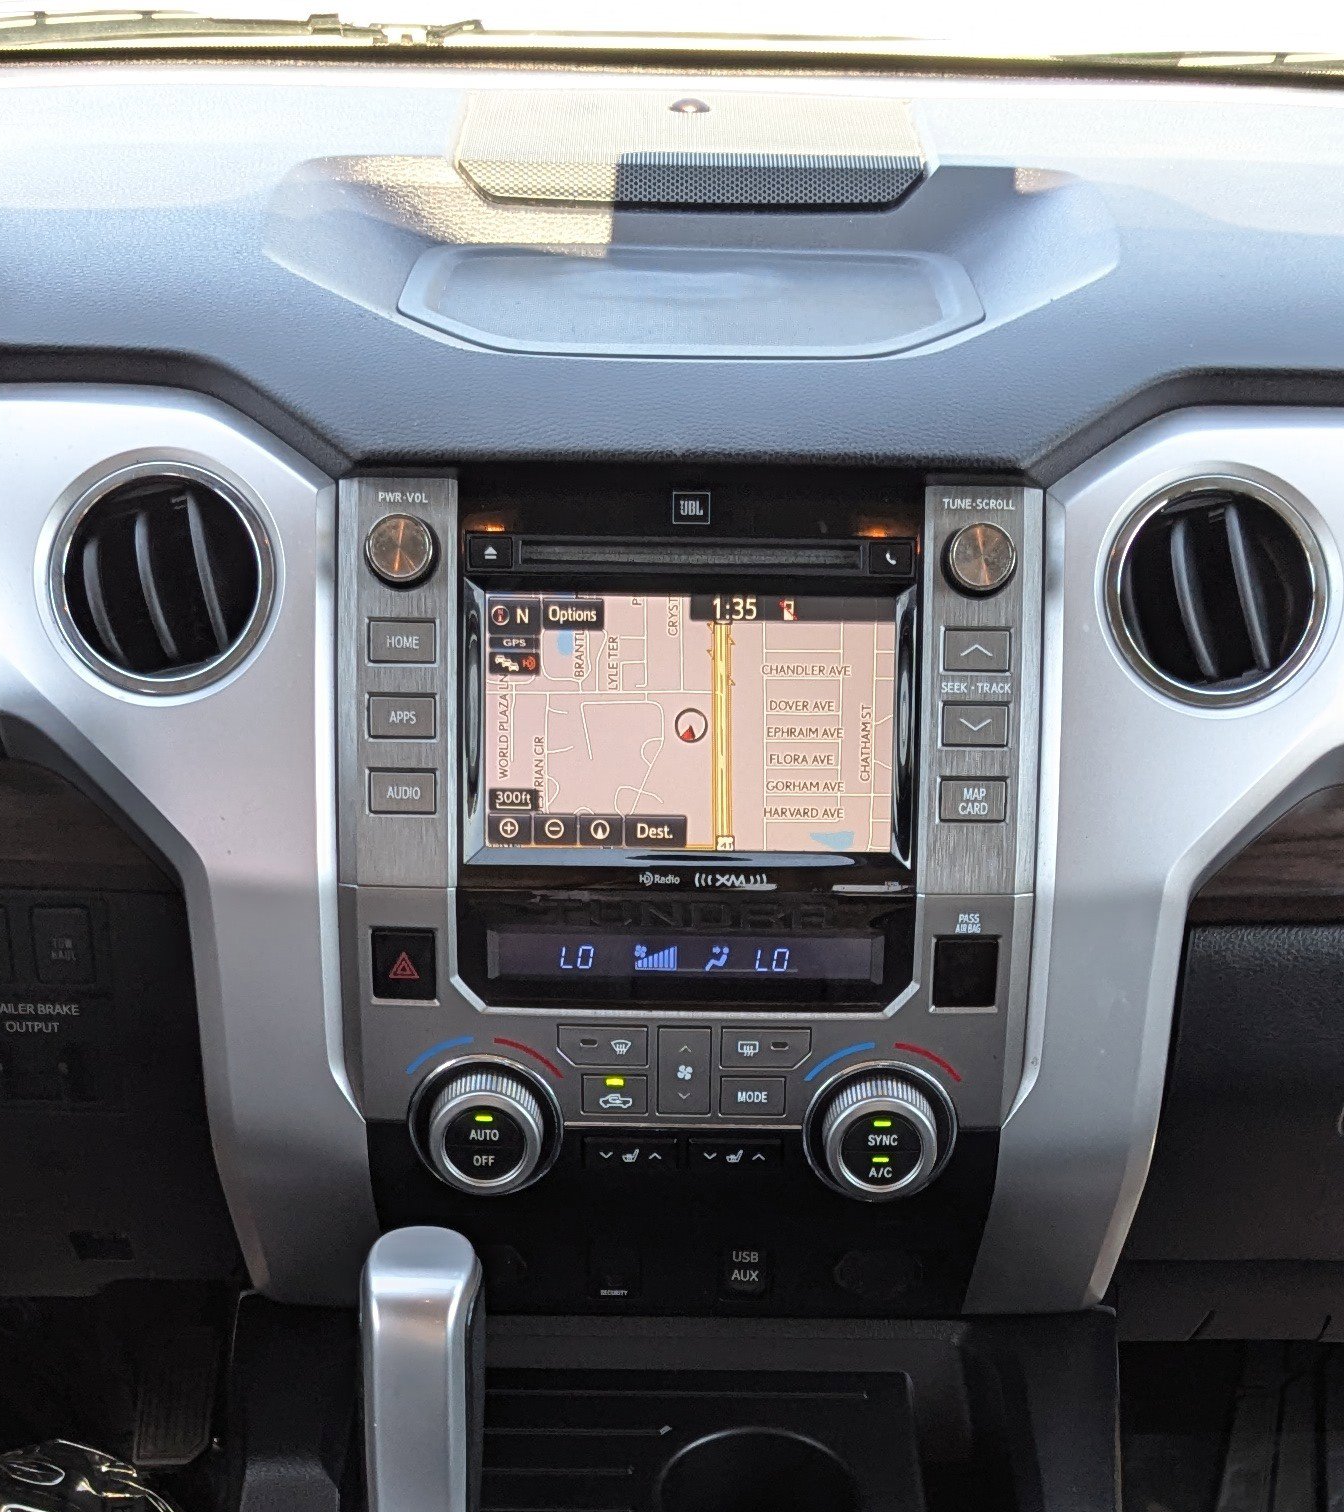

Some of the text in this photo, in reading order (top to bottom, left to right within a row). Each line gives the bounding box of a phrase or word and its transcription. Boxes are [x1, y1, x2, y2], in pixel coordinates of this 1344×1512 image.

[679, 500, 704, 516] JBL
[516, 606, 597, 624] N Options
[712, 598, 757, 620] 1:35
[385, 634, 420, 650] HOME
[503, 638, 527, 648] GPS
[608, 636, 619, 690] LYLE TER
[761, 664, 851, 677] CHANDLER AVE
[941, 682, 1012, 694] SEEK TRACK
[769, 700, 835, 712] DOVER AVE
[389, 711, 417, 725] APPS
[499, 694, 510, 732] PLAZA
[767, 727, 844, 739] EPHRAIM AVE
[534, 736, 544, 755] CIR
[859, 704, 872, 782] CHATHAM ST
[499, 734, 510, 780] WORLD
[769, 753, 834, 765] FLORA AVE
[387, 785, 421, 800] AUDIO
[766, 780, 845, 793] GORHAM AVE
[496, 791, 531, 804] 300ft
[963, 788, 987, 800] MAP
[764, 807, 844, 819] HARVARD AVE
[958, 802, 988, 815] CARD
[636, 823, 673, 839] Dest.
[654, 874, 681, 885] Radio
[958, 913, 980, 924] PASS
[37, 1003, 81, 1016] BRAKE
[4, 1021, 60, 1033] OUTPUT
[737, 1091, 768, 1103] MODE
[469, 1129, 500, 1141] AUTO
[867, 1134, 899, 1146] SYNC
[472, 1155, 496, 1167] OFF
[868, 1167, 893, 1178] A/C
[732, 1250, 759, 1263] USB
[731, 1269, 759, 1282] AUX
